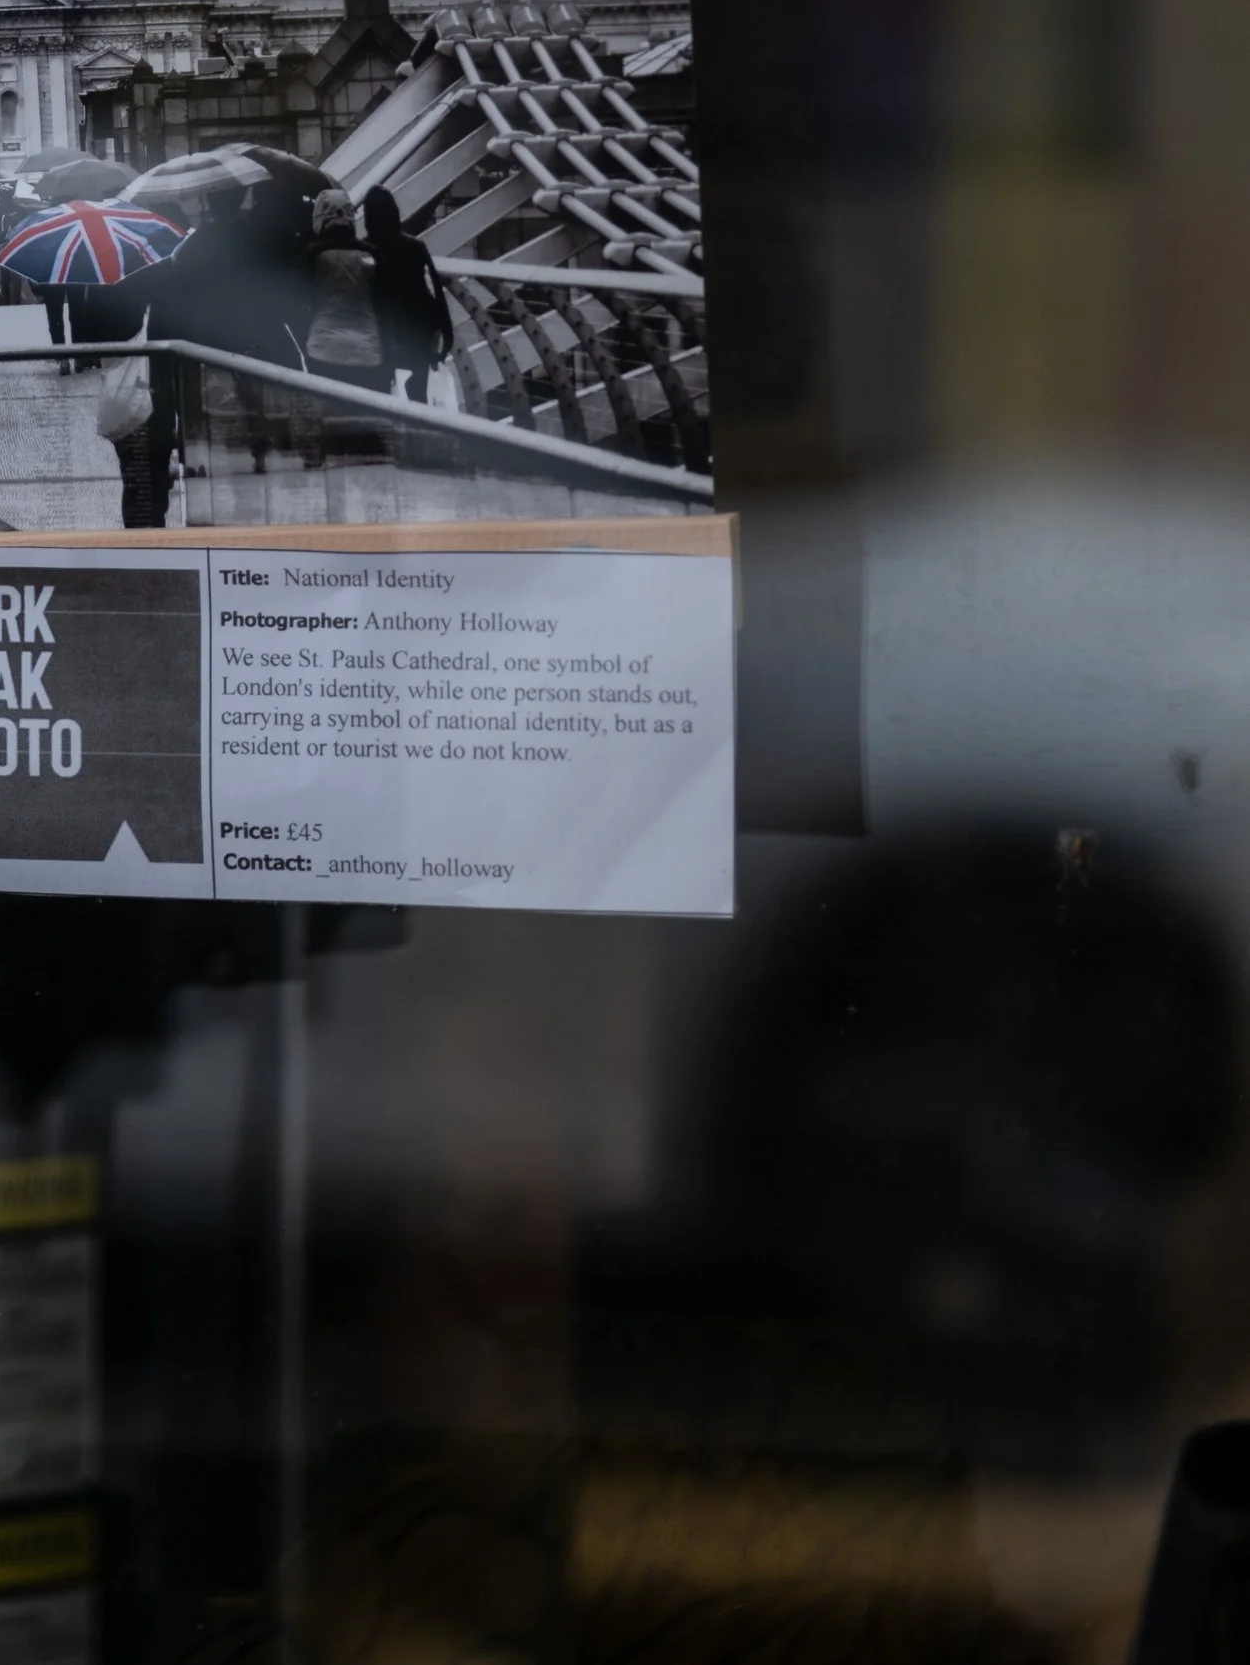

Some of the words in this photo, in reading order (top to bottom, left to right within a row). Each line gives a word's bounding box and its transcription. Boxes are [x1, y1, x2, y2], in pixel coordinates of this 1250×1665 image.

[219, 569, 269, 586] Title:
[283, 568, 369, 587] National
[377, 570, 454, 593] Identity
[220, 610, 359, 632] Photographer:
[363, 611, 452, 636] Anthony
[461, 612, 557, 638] Holloway
[222, 647, 254, 666] We
[261, 653, 292, 668] see
[298, 649, 324, 668] St.
[332, 650, 385, 669] Pauls
[392, 650, 497, 672] Cathedral,
[504, 658, 540, 672] one
[548, 654, 621, 678] symbol
[629, 654, 653, 673] of
[222, 676, 313, 698] London's
[320, 679, 399, 704] identity,
[408, 680, 463, 701] while
[470, 687, 507, 701] one
[514, 688, 581, 707] person
[589, 684, 652, 704] stands
[658, 688, 698, 706] out,
[221, 707, 304, 731] carrying
[310, 713, 322, 727] a
[328, 709, 400, 733] symbol
[407, 710, 433, 729] of
[437, 711, 517, 731] national
[526, 712, 607, 737] identity,
[615, 714, 646, 733] but
[654, 720, 676, 734] as
[682, 720, 694, 734] a
[221, 735, 301, 755] resident
[306, 743, 328, 757] or
[333, 739, 398, 758] tourist
[404, 745, 434, 759] we
[440, 740, 465, 759] do
[472, 744, 505, 760] not
[511, 741, 571, 762] know.
[220, 821, 279, 840] Price:
[285, 822, 323, 843] £45
[223, 852, 312, 872] Contact:
[316, 855, 515, 883] _anthony_holloway
